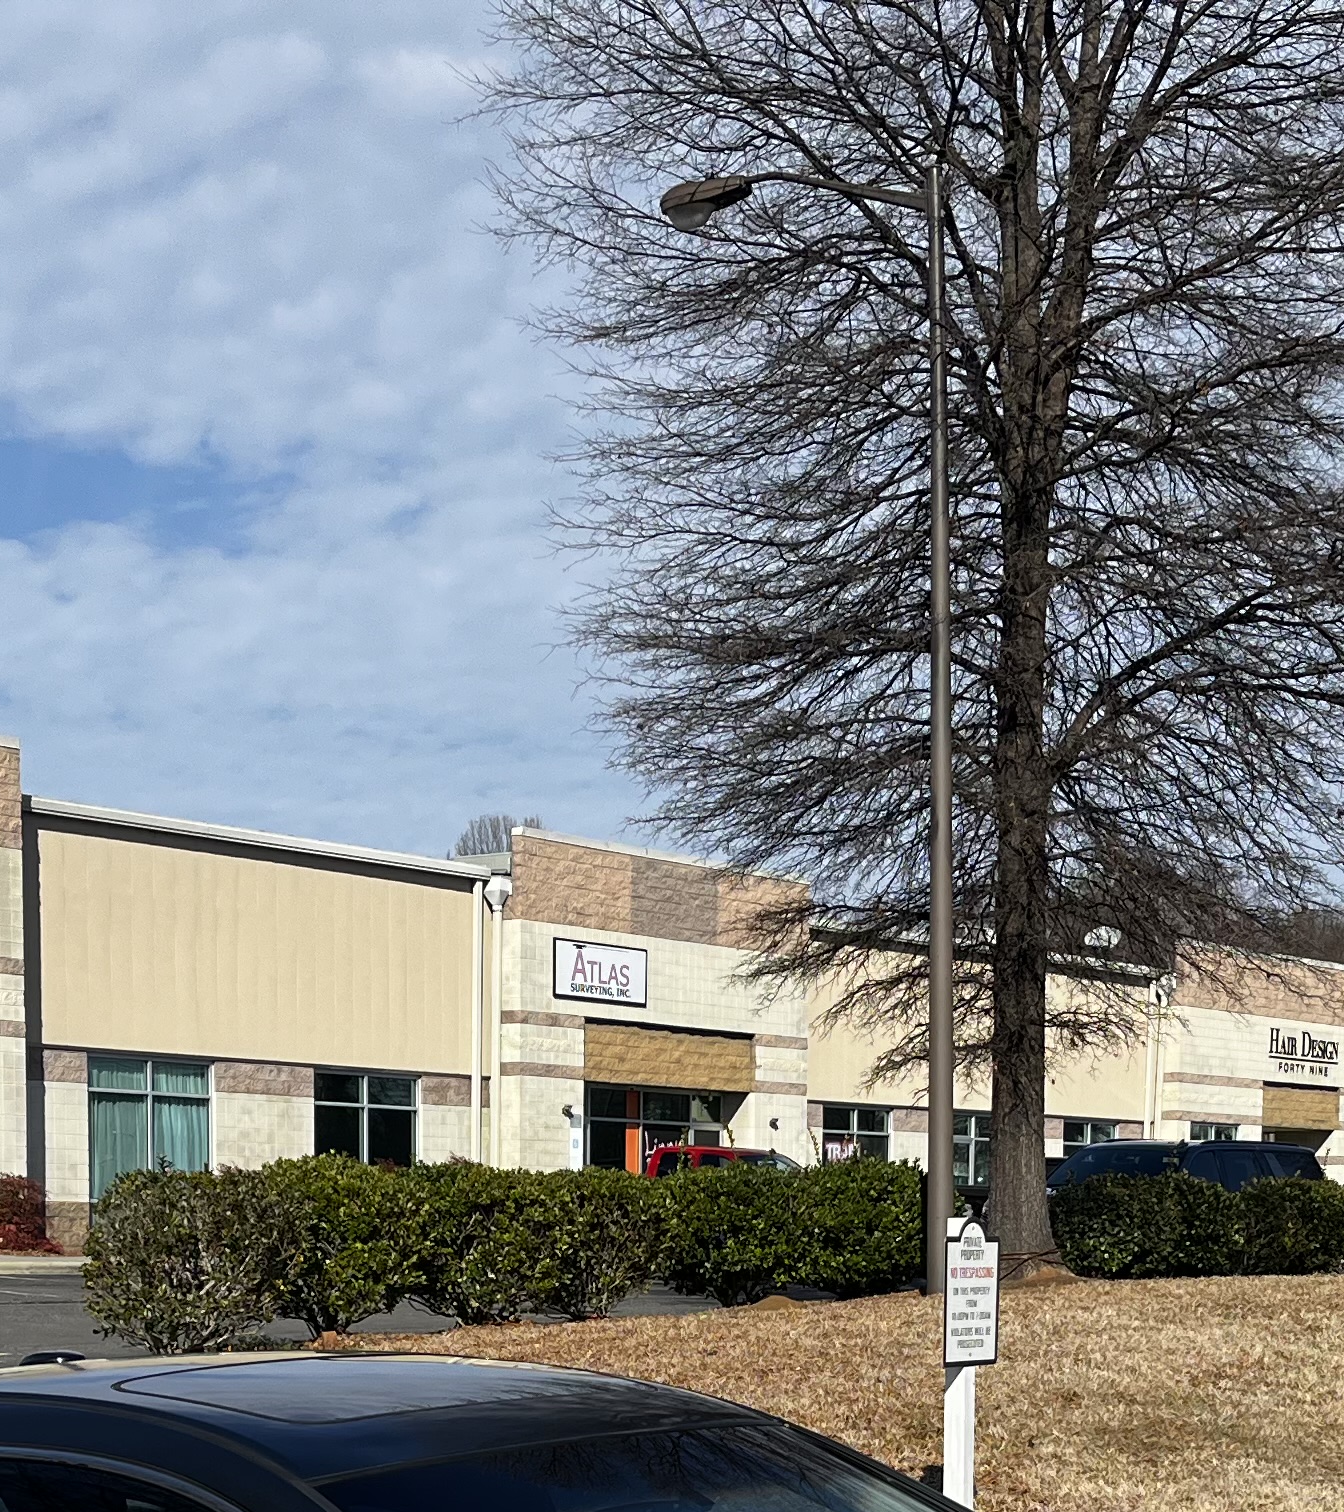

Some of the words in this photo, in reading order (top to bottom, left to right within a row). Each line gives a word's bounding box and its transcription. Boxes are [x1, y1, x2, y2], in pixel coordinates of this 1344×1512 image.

[571, 949, 631, 988] ATLAS
[570, 982, 615, 998] SURVEYING,
[1278, 1061, 1305, 1074] FORTY
[1309, 1065, 1329, 1077] NINE
